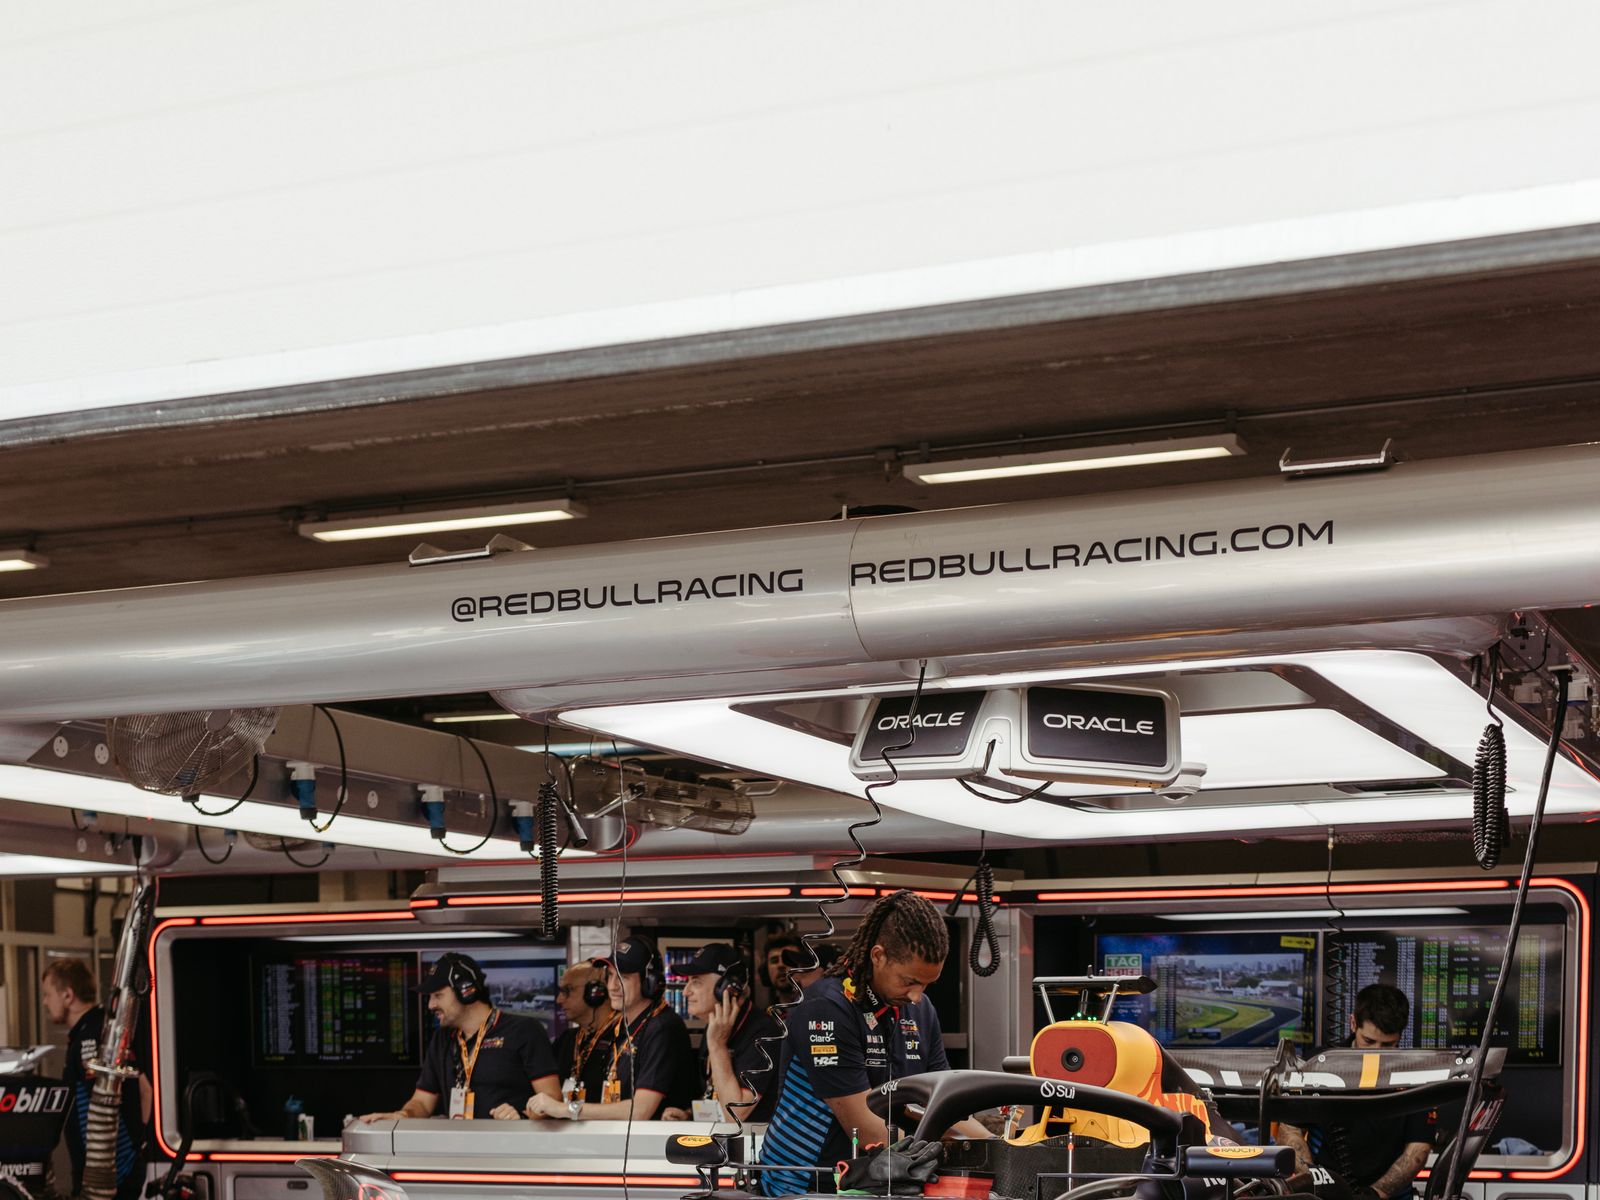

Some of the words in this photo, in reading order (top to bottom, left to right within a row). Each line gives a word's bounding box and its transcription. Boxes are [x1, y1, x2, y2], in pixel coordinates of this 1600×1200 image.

[850, 519, 1334, 587] REDBULLRACING.COM
[451, 568, 803, 622] @REDBULLRACING
[877, 710, 966, 731] ORACLE
[1042, 713, 1154, 736] ORACLE
[1108, 957, 1140, 967] TAG
[808, 1020, 834, 1031] Mobil
[809, 1033, 831, 1043] Claro
[814, 1056, 839, 1066] HRC
[1056, 1084, 1076, 1099] Sui
[0, 1087, 46, 1113] obil
[0, 1161, 31, 1176] ayer
